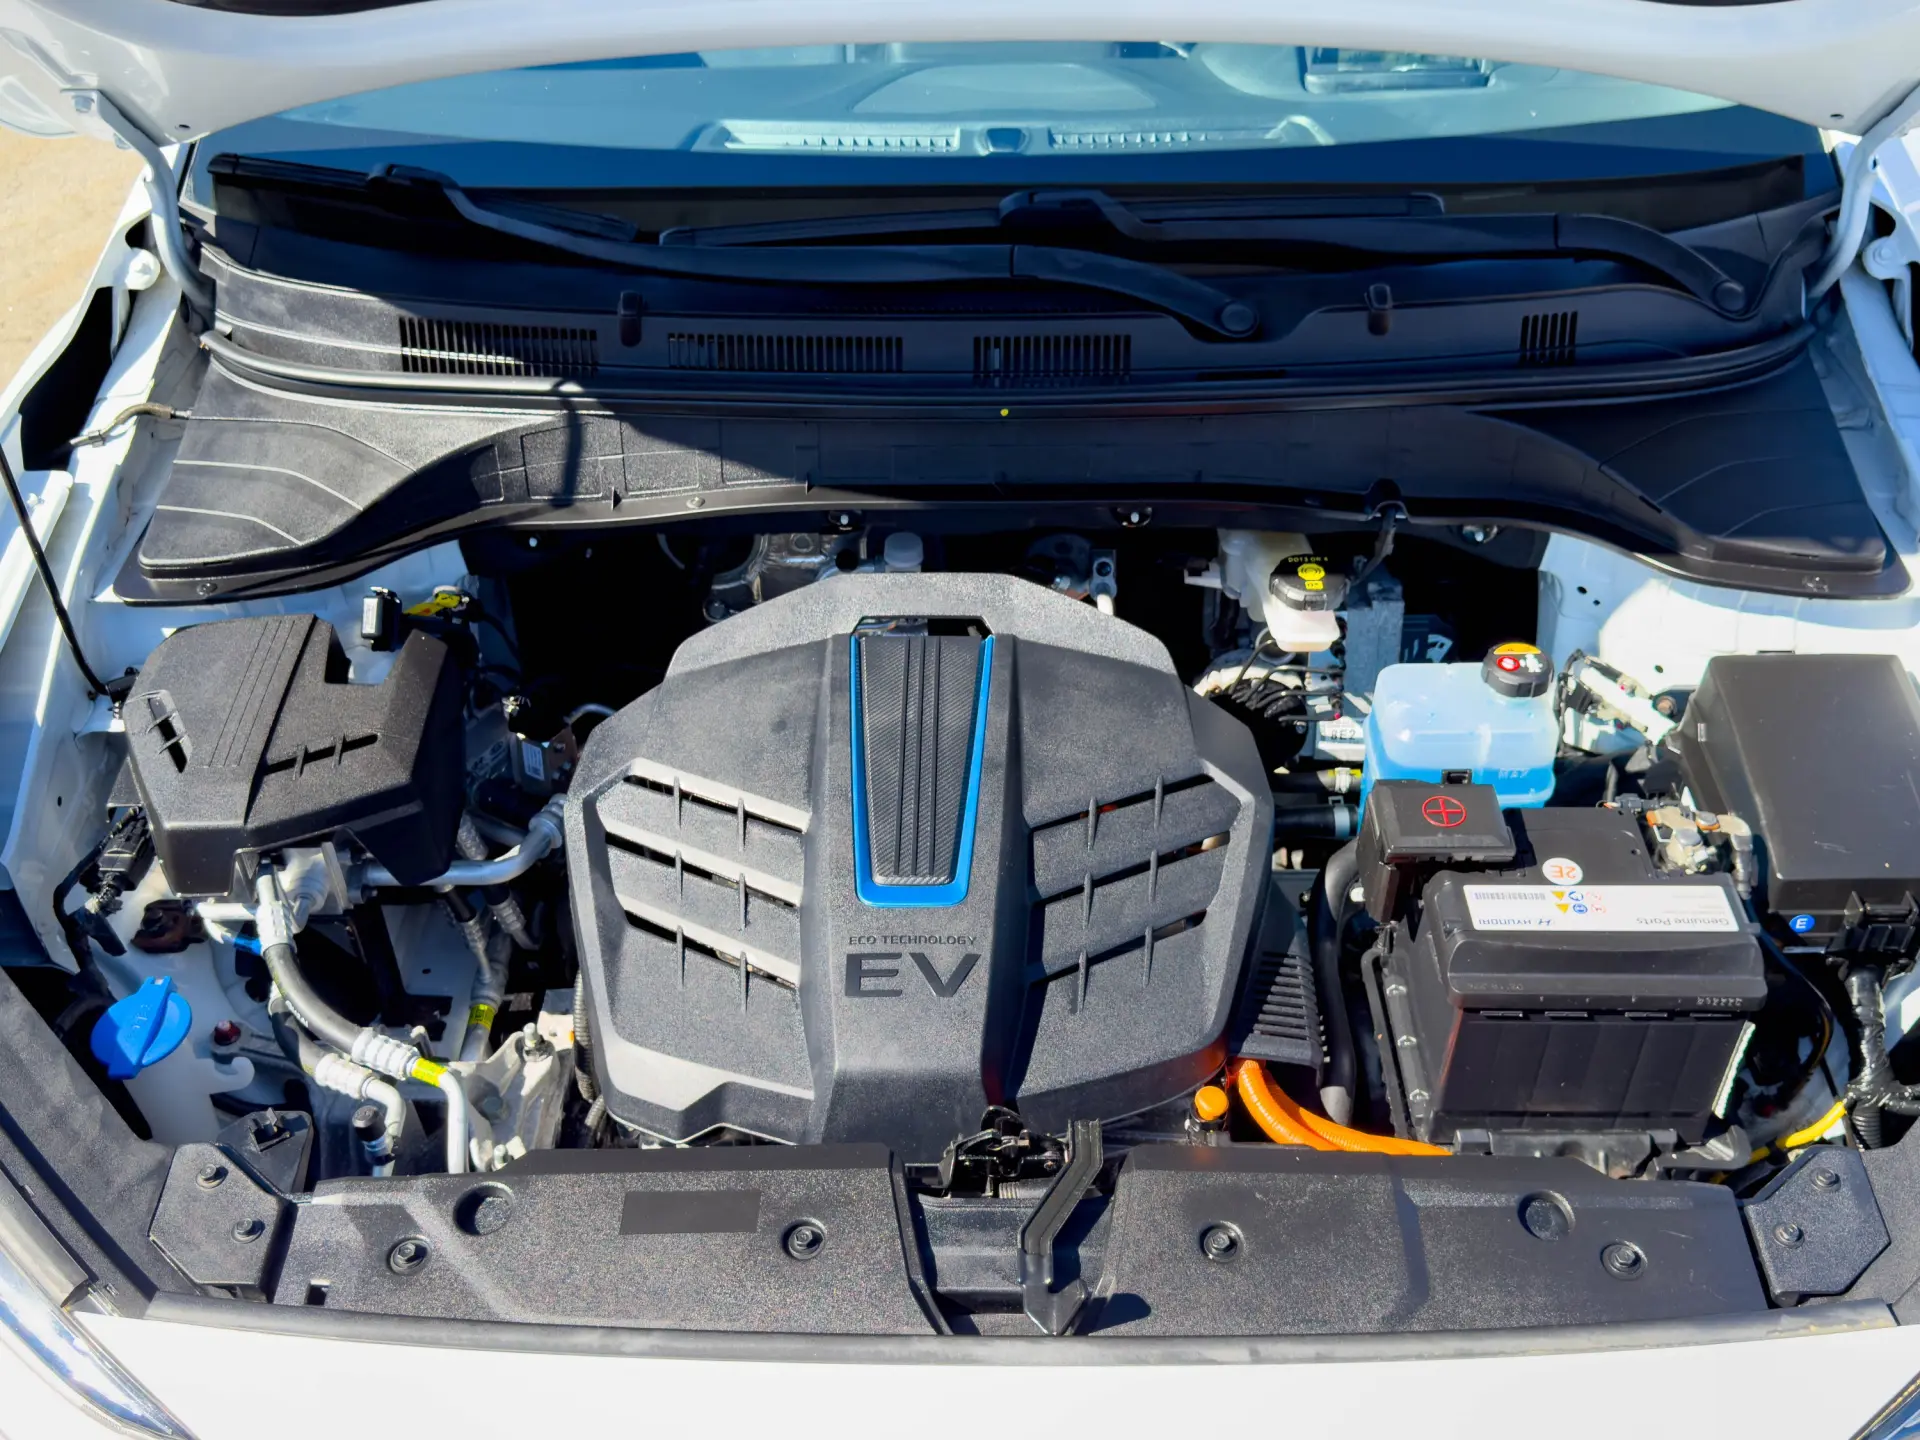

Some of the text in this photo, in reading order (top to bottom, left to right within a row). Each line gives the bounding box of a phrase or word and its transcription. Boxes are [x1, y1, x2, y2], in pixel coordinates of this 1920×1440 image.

[1550, 865, 1576, 879] 2E
[1636, 917, 1729, 926] Genuine Parts
[1795, 917, 1808, 929] E
[849, 935, 977, 945] ECO TECHNOLOGY
[845, 953, 982, 998] EV
